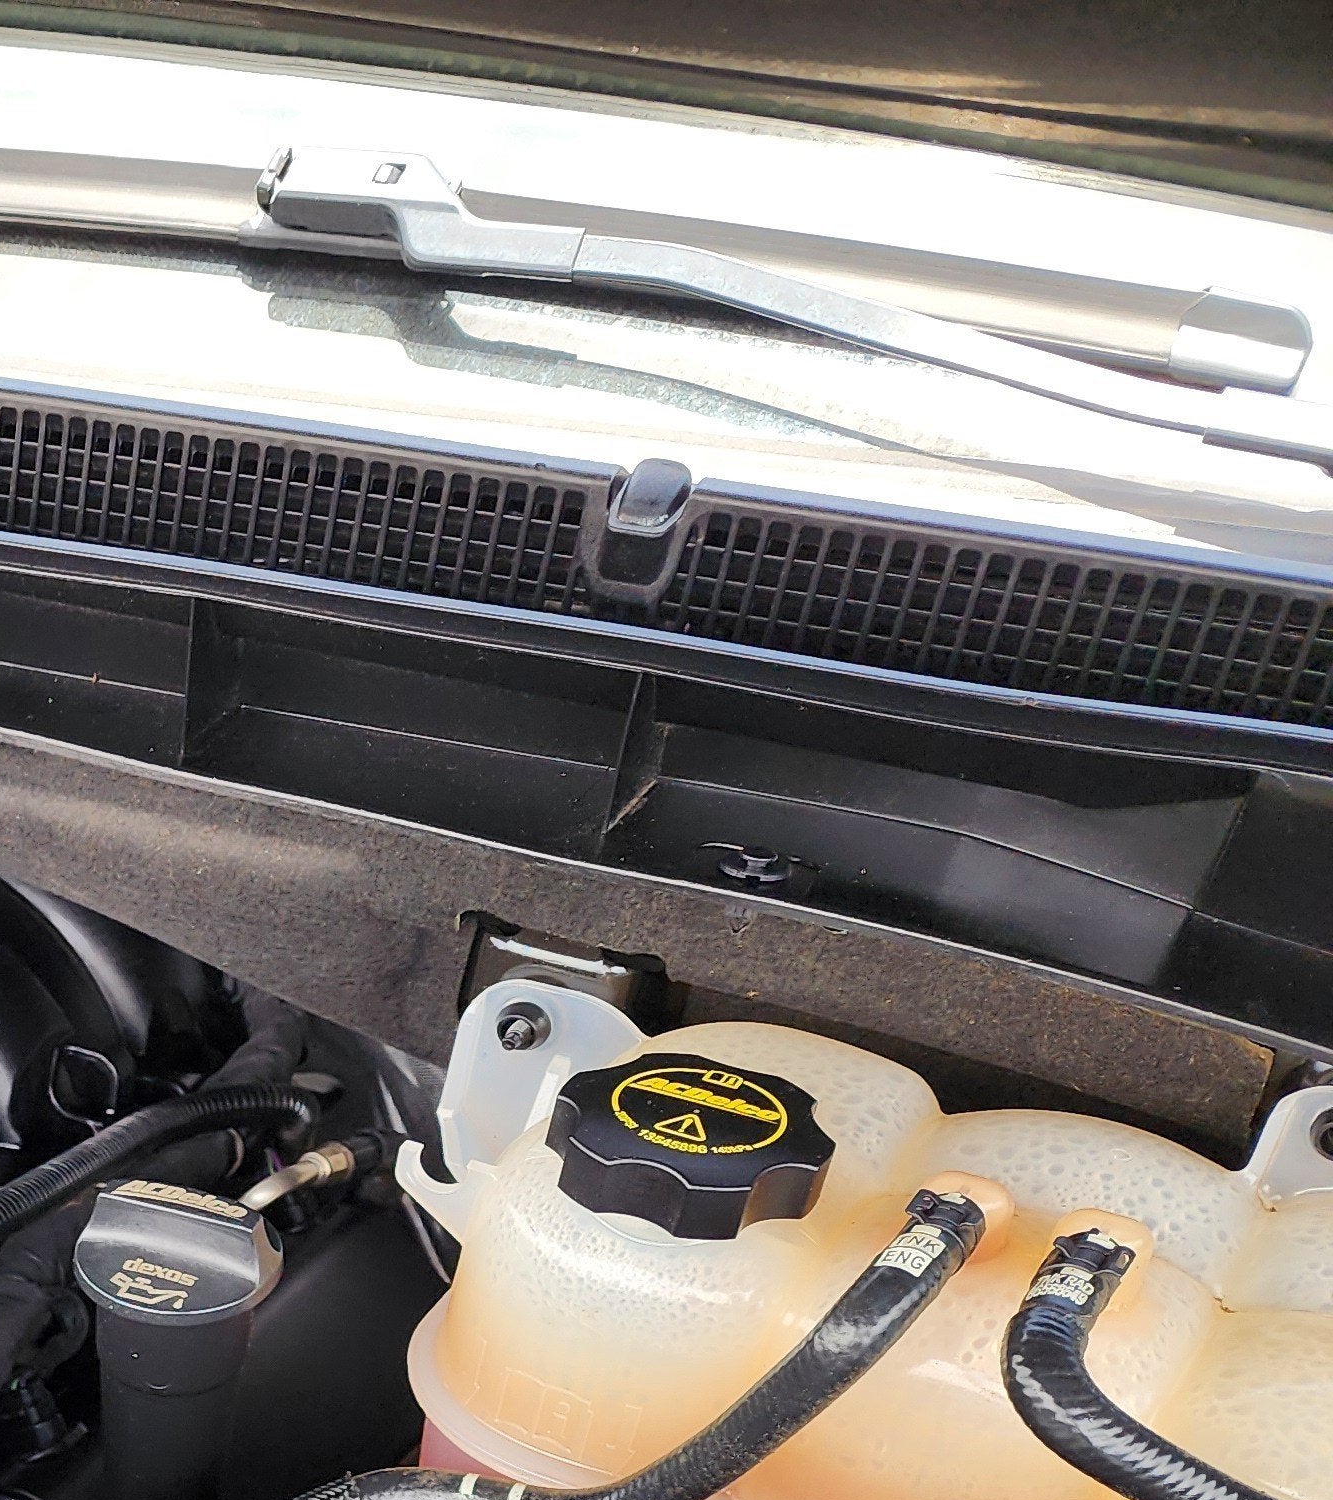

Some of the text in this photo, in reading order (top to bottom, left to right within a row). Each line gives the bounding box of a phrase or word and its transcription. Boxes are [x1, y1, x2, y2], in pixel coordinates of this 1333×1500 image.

[641, 1076, 781, 1121] ACDelco
[117, 1179, 249, 1219] ACDelco
[896, 1234, 940, 1253] TNK
[881, 1250, 926, 1269] ENG
[122, 1258, 200, 1287] dexos
[1063, 1275, 1095, 1296] RAD
